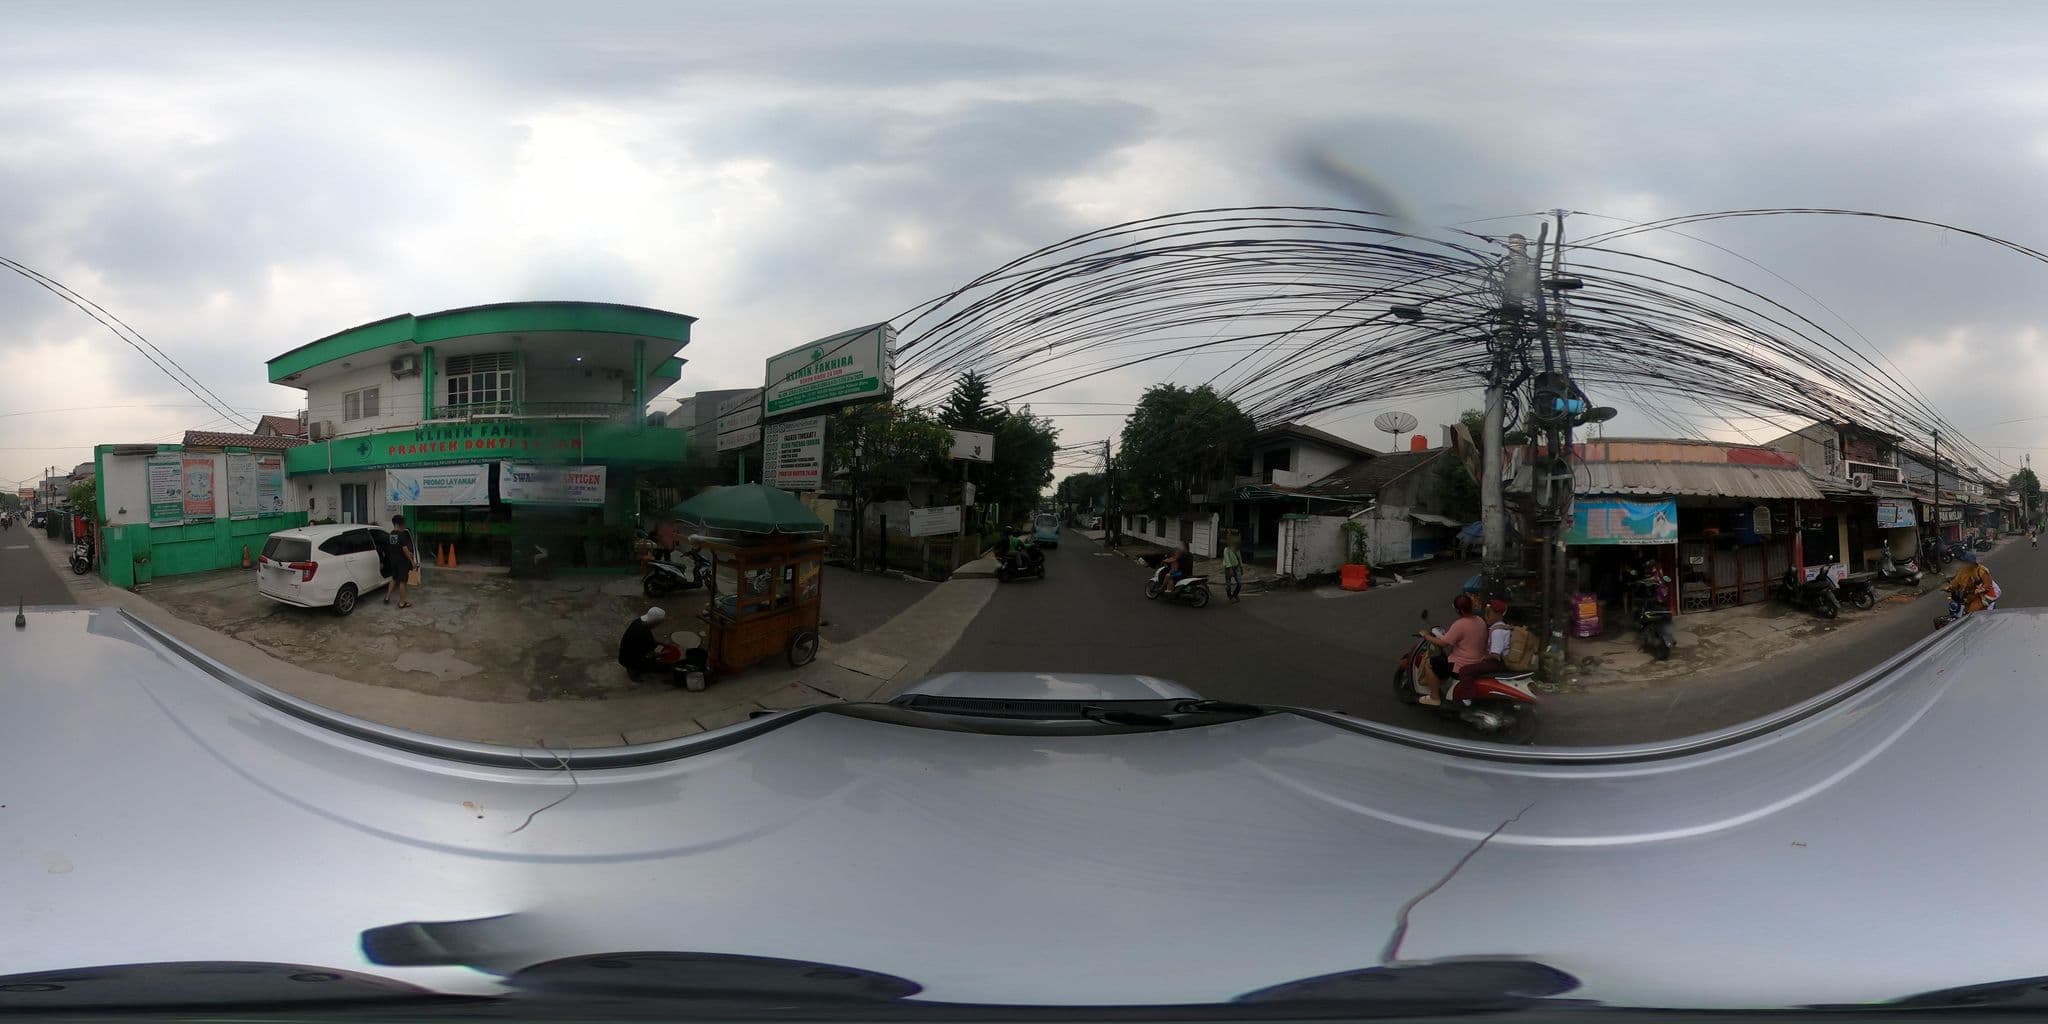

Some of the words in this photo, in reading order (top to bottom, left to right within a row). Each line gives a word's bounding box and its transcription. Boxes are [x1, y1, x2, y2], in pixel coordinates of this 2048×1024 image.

[815, 356, 854, 374] FAKHIRA
[415, 426, 473, 442] KLINIK
[387, 439, 458, 456] PRAKTEK
